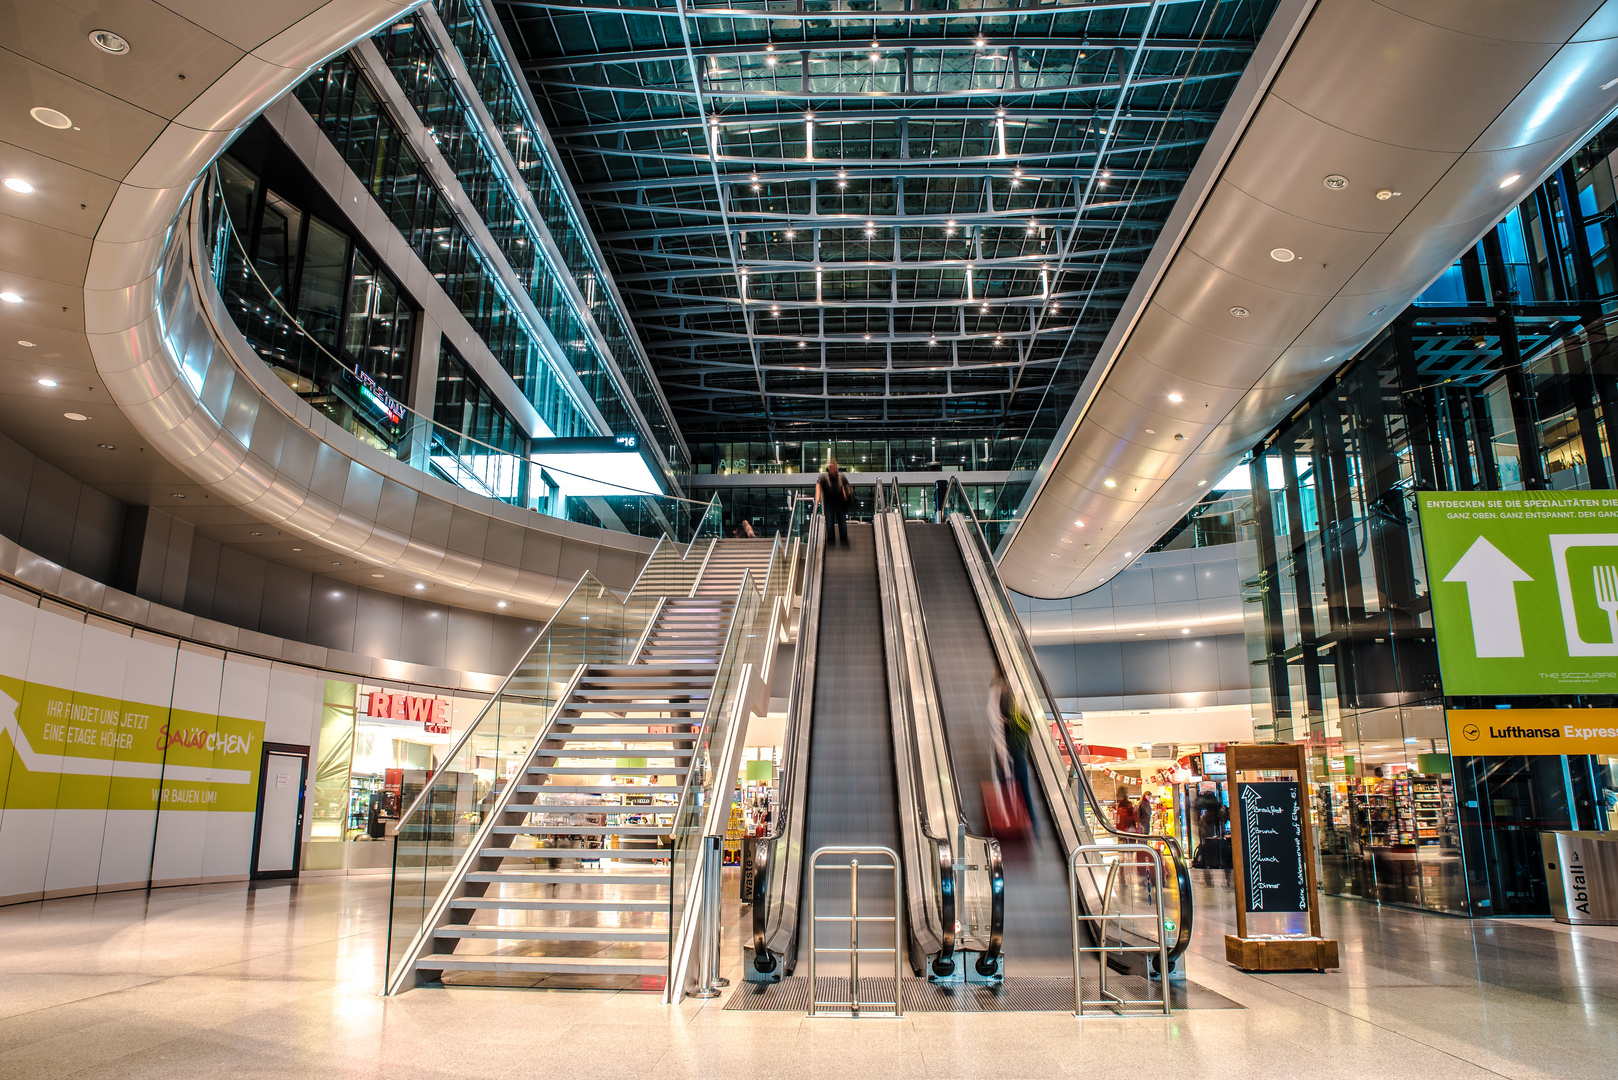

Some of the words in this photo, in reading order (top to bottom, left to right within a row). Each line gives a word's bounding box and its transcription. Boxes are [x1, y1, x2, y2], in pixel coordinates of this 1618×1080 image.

[1426, 500, 1485, 508] ENTDECKEN
[1487, 500, 1503, 508] SIE
[1505, 500, 1521, 508] DIE
[1523, 498, 1600, 508] SPEZIALITÄTEN
[1525, 511, 1577, 519] ENTSPANNT.
[47, 700, 64, 718] IHR
[65, 703, 99, 723] FINDET
[100, 708, 119, 726] UNS
[121, 712, 149, 730] JETZT
[368, 692, 447, 724] REWE
[43, 723, 65, 742] EINE
[66, 726, 98, 745] ETAGE
[100, 729, 133, 749] HÖHER
[425, 725, 451, 735] CITY
[1489, 726, 1560, 739] Lufthansa
[1563, 725, 1618, 740] Expres
[152, 788, 170, 802] WIR
[171, 789, 200, 803] BAUEN
[201, 790, 218, 804] UM!
[745, 860, 753, 896] waste
[1570, 865, 1591, 915] Abfall
